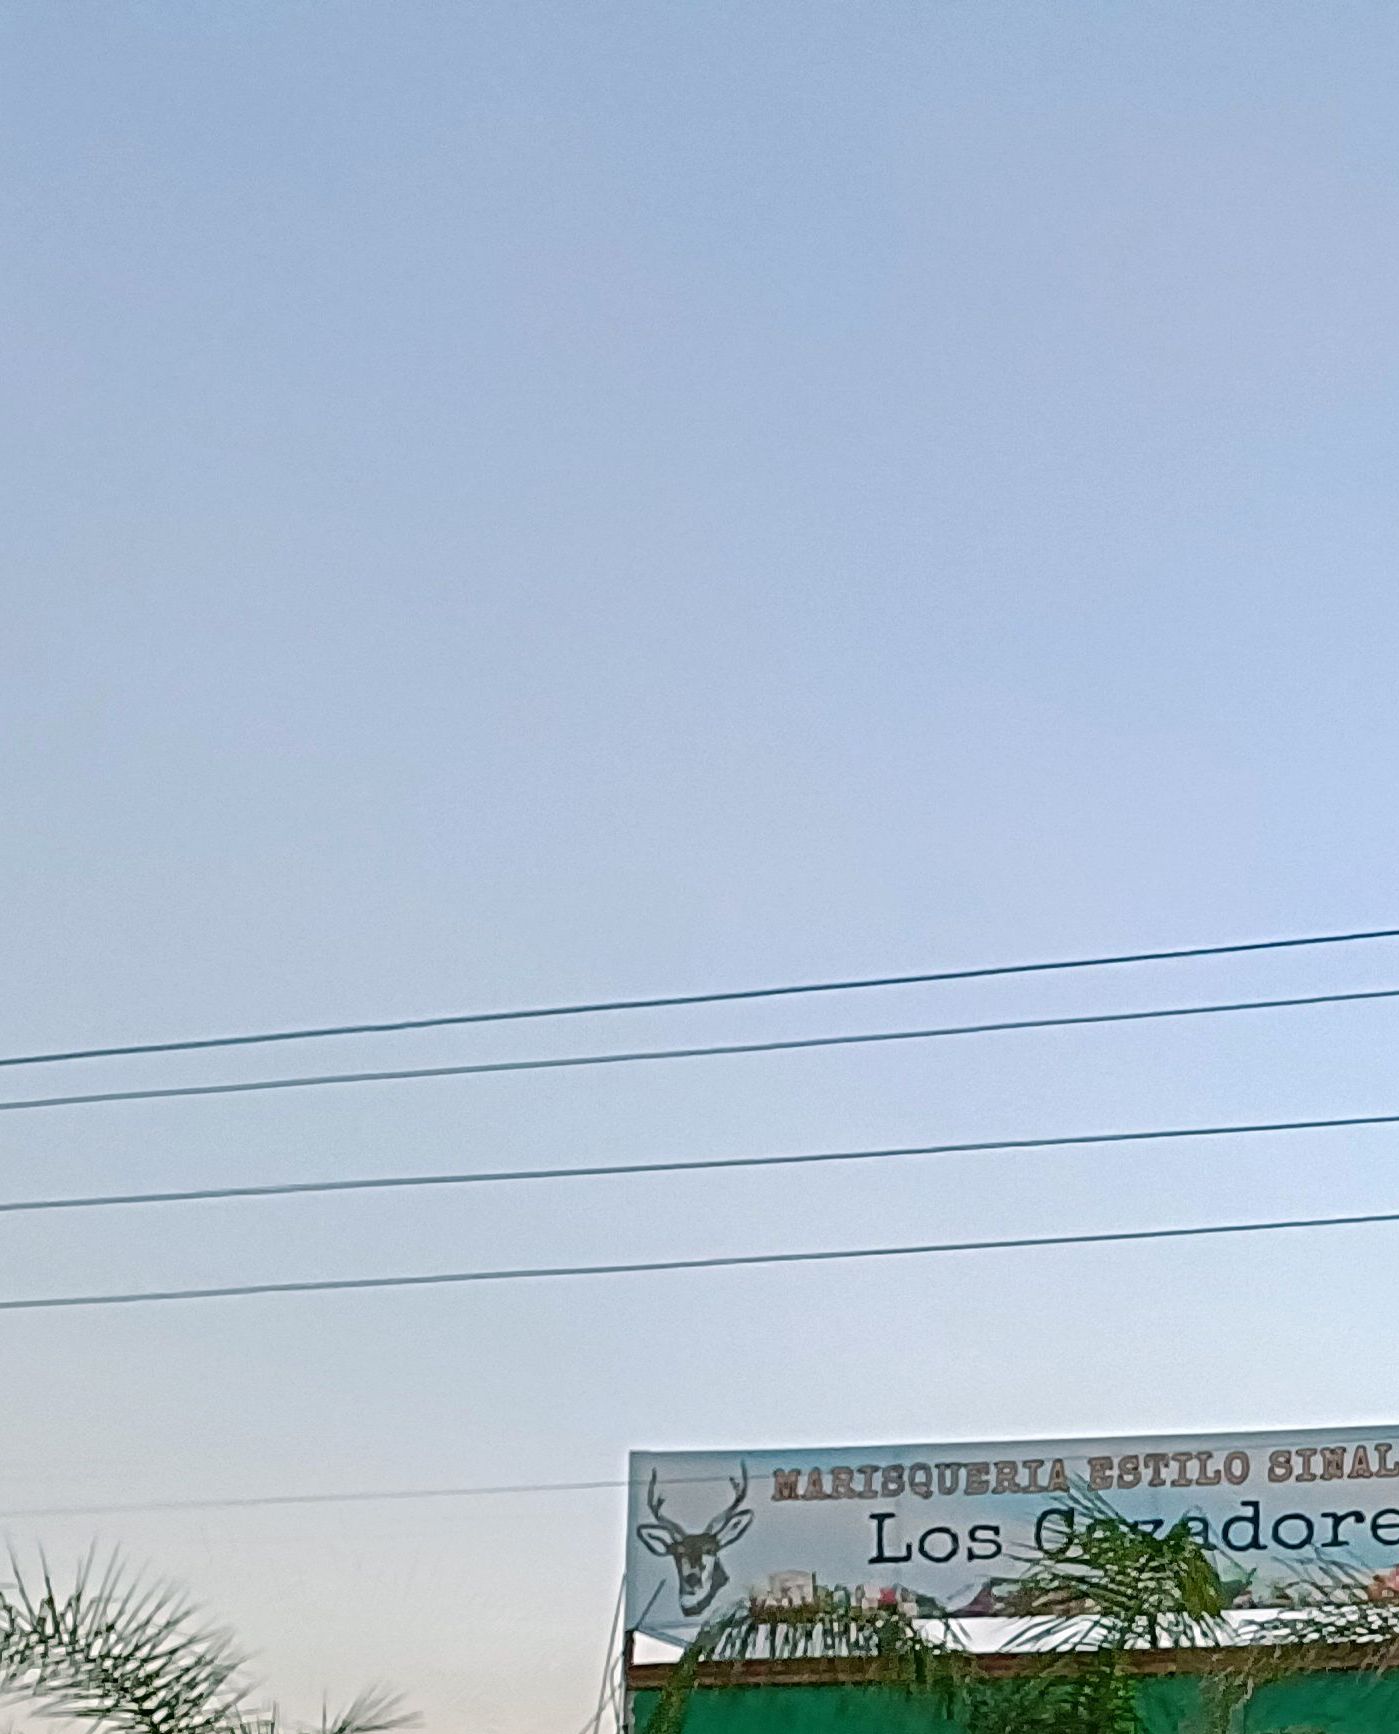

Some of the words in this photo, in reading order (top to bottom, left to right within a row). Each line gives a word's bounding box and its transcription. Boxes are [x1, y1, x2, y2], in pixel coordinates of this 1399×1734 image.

[771, 1458, 1070, 1501] MARISQUERIA
[1087, 1450, 1251, 1492] ESTILO
[868, 1512, 1002, 1564] Los
